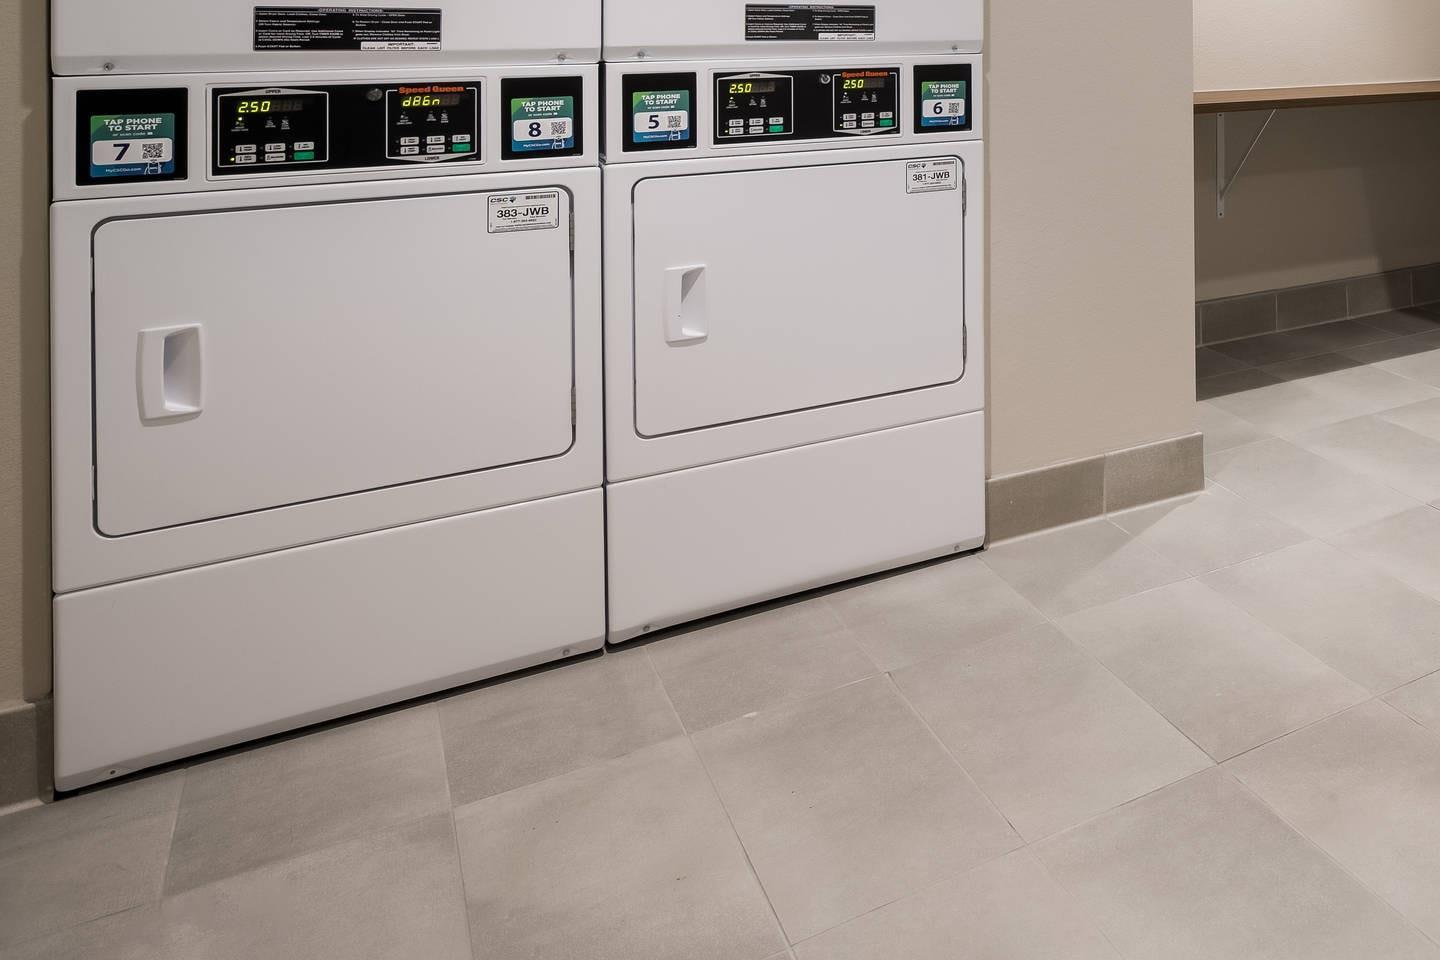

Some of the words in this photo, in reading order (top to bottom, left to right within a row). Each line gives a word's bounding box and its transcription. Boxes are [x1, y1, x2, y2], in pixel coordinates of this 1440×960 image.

[399, 86, 431, 95] Speed
[432, 85, 465, 93] Queen
[729, 83, 752, 93] 2.50
[843, 79, 864, 89] 2.50
[238, 100, 271, 113] 2.50
[933, 102, 943, 115] 6
[126, 117, 162, 125] PHONE
[648, 115, 660, 129] 5
[528, 121, 542, 137] 8
[113, 143, 130, 161] 7
[912, 171, 950, 181] 381-JWB
[496, 206, 550, 218] 383-JWB
